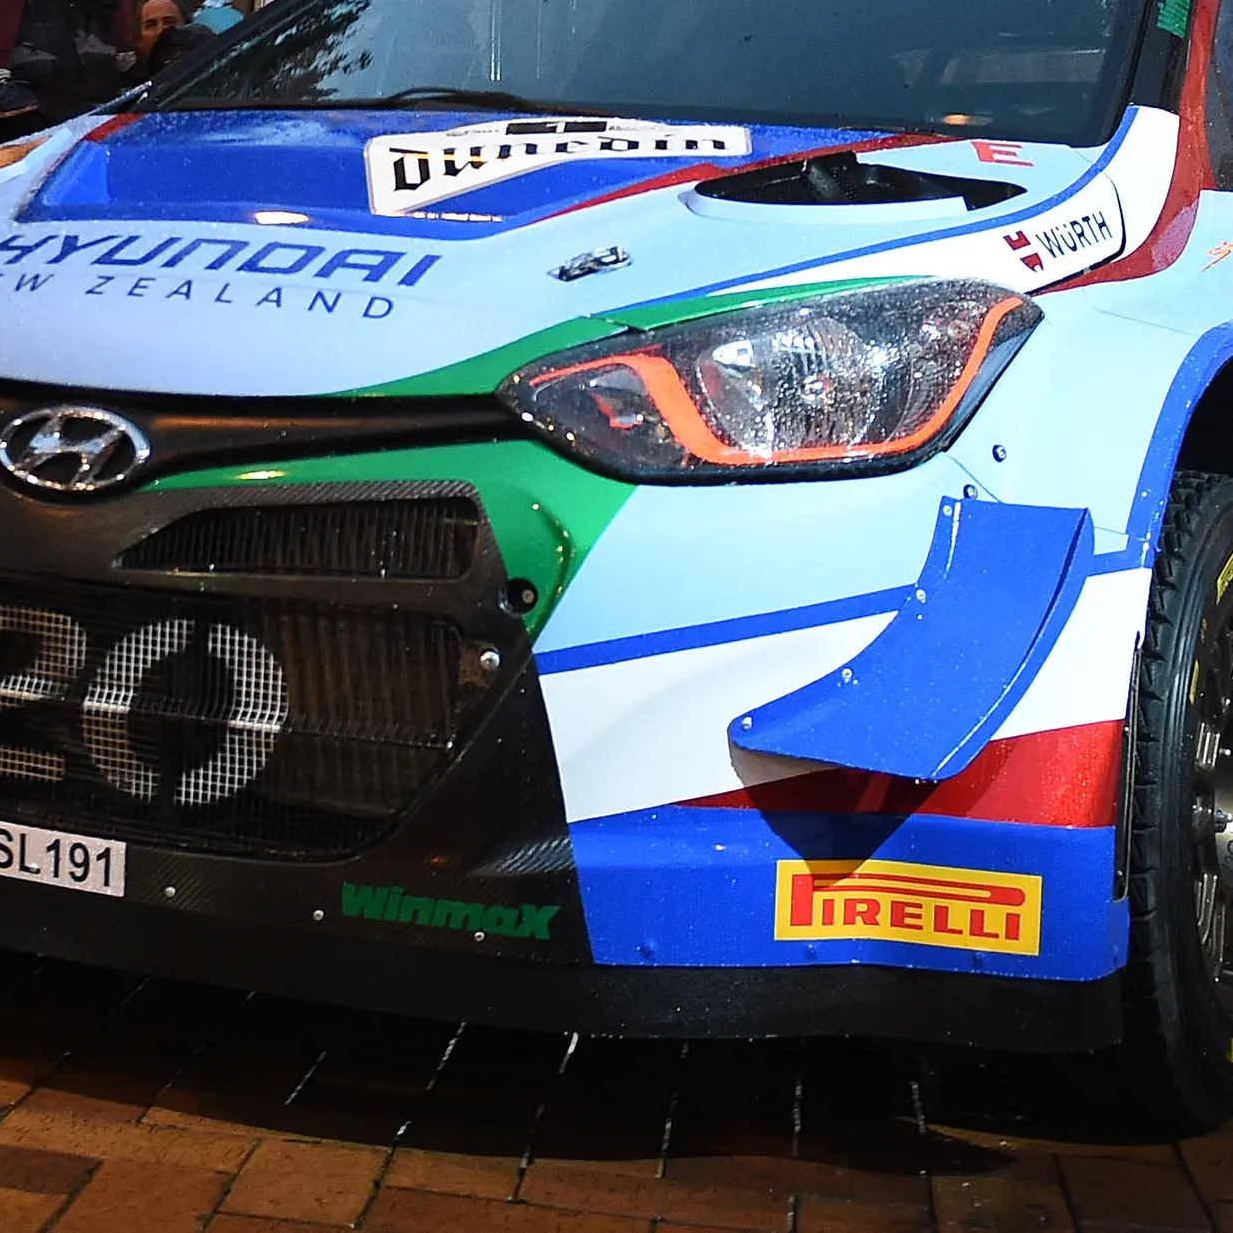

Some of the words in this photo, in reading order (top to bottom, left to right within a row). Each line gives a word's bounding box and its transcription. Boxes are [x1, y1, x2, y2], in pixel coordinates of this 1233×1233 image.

[971, 141, 1034, 167] E
[85, 275, 396, 319] ZEALAND
[790, 873, 1026, 941] PIRELLI
